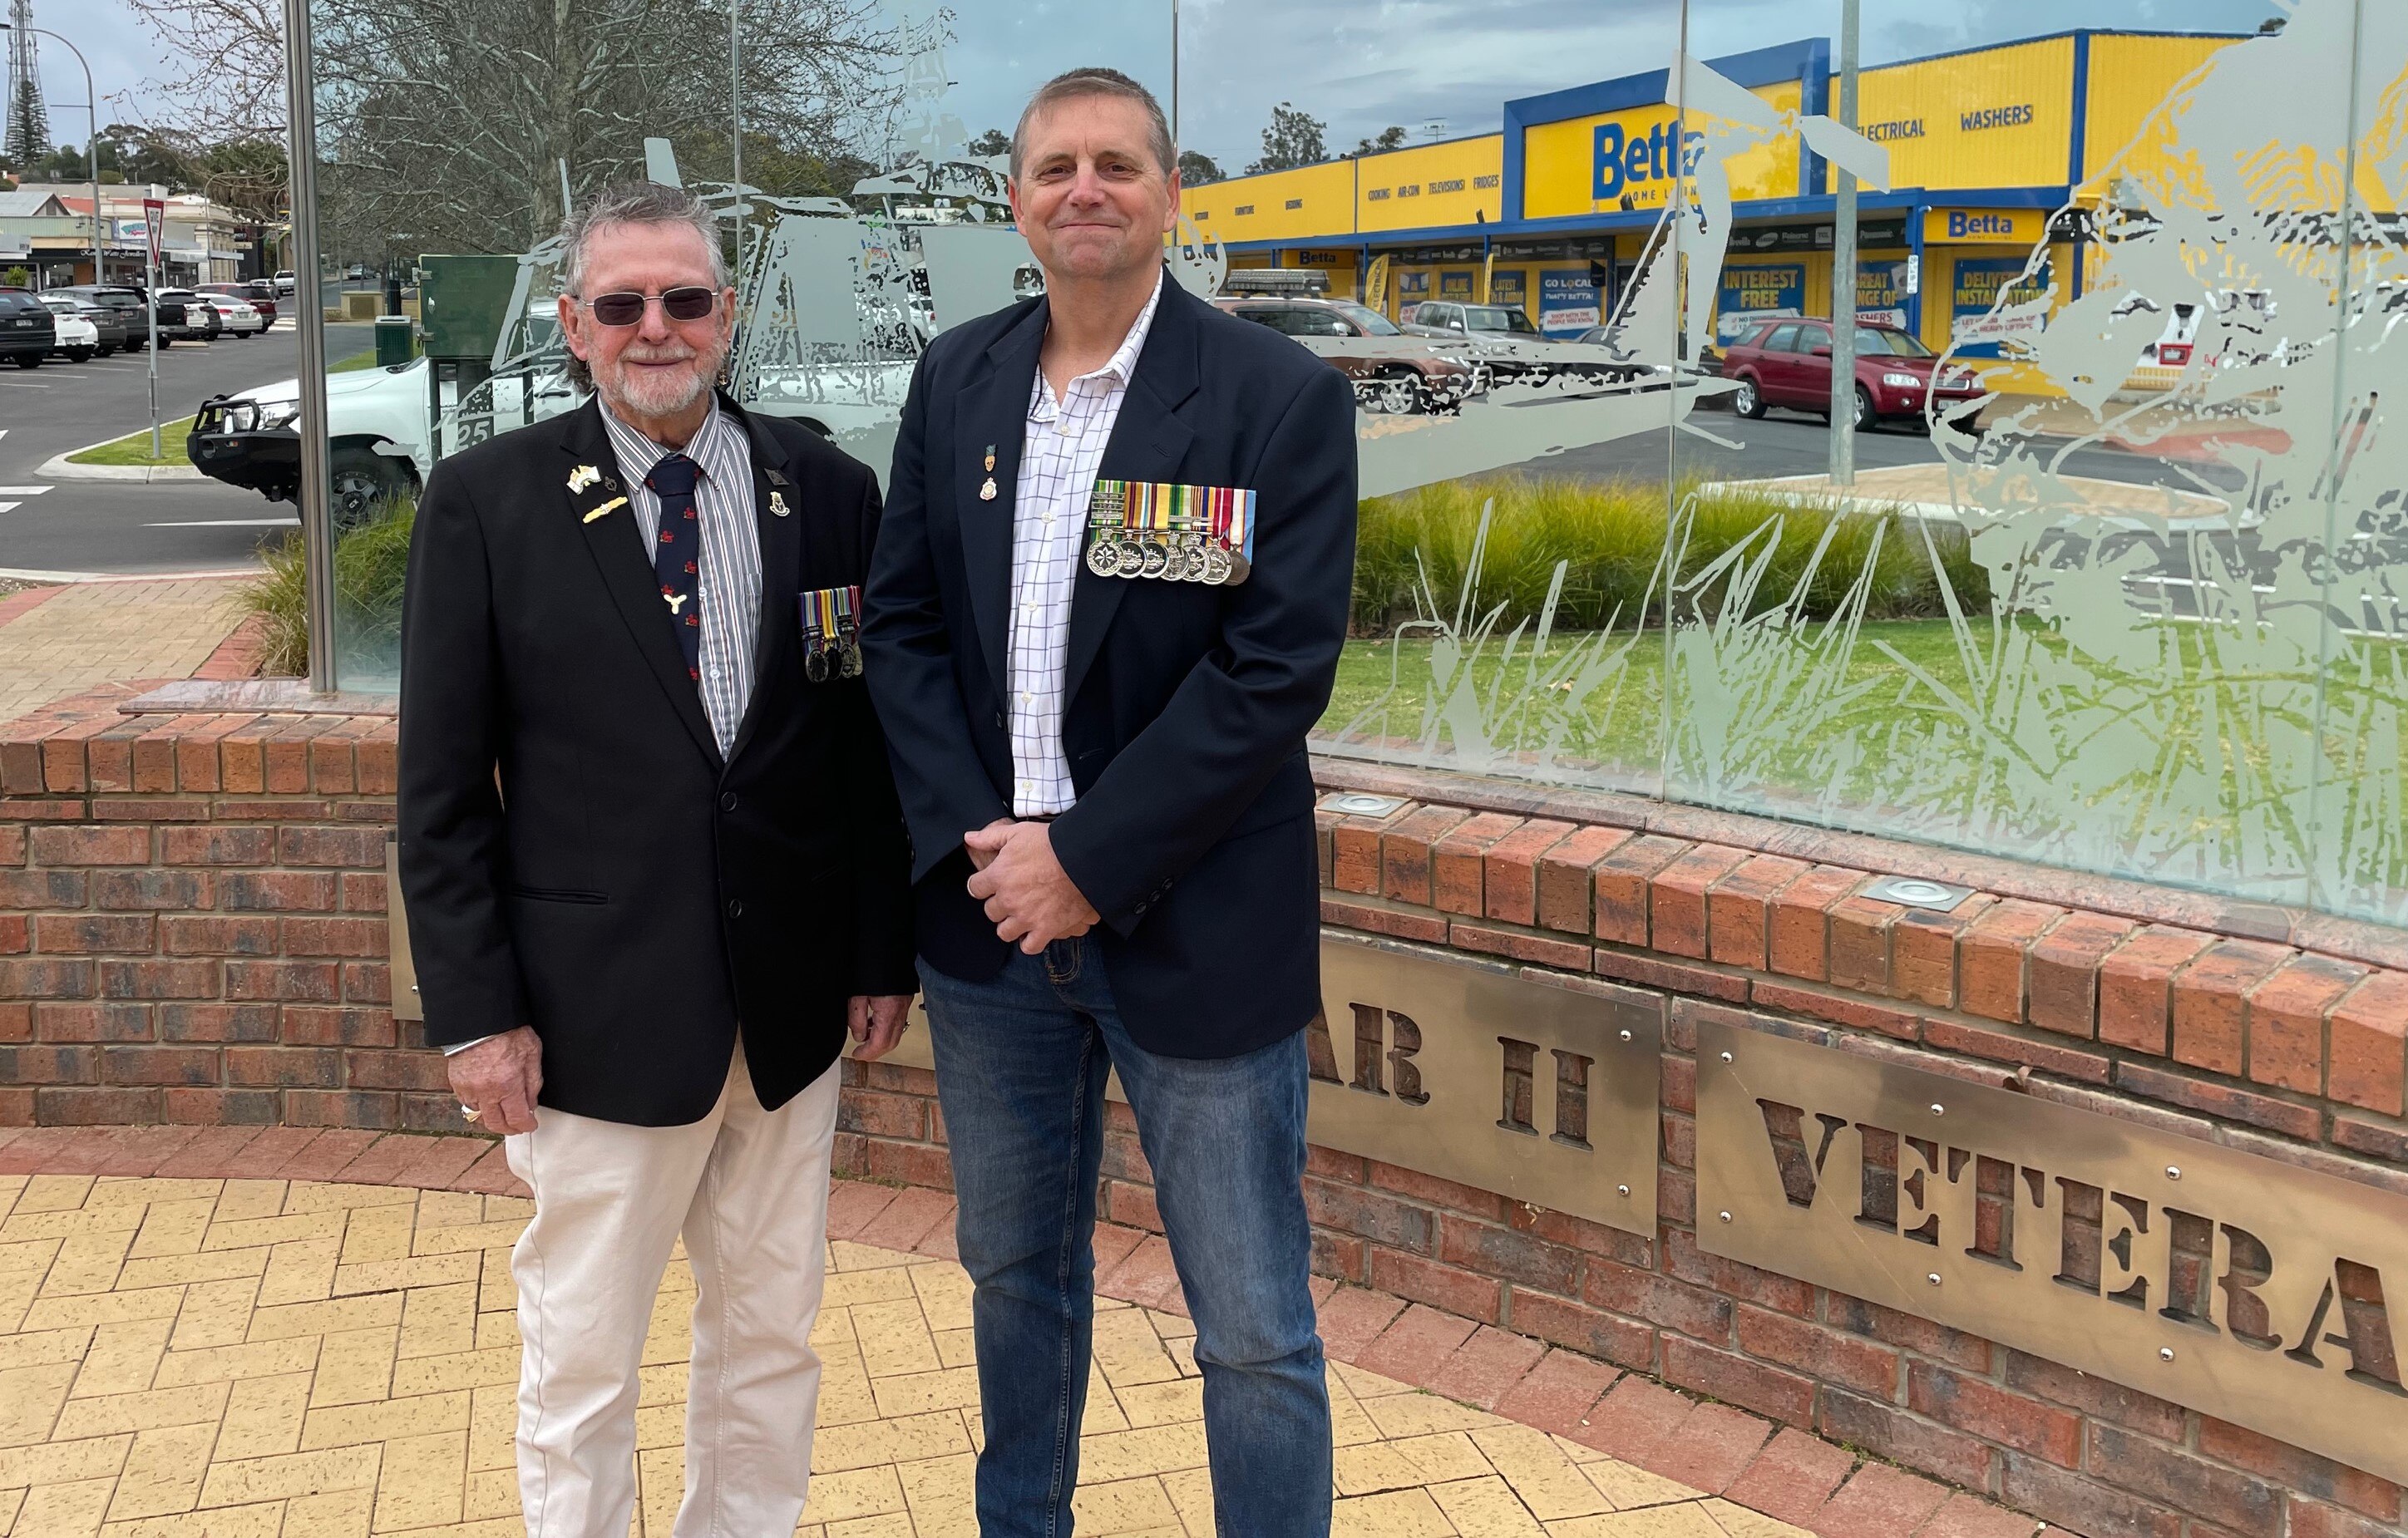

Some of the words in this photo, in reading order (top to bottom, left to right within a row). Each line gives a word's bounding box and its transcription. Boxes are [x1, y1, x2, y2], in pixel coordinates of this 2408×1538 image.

[1960, 104, 2035, 131] WASHERS
[1858, 118, 1926, 141] ECTRICAL
[1473, 174, 1500, 190] FRIDGES
[1948, 211, 2013, 238] Betta
[1299, 250, 1337, 266] Betta
[1494, 279, 1517, 291] LATEST
[1544, 279, 1558, 288] GO
[1560, 279, 1594, 290] LOCAL
[1724, 270, 1798, 288] INTEREST
[1567, 292, 1594, 300] BETTA!
[1740, 289, 1779, 308] FREE
[1856, 290, 1880, 306] NGE
[1882, 290, 1897, 306] OF
[1855, 313, 1893, 323] ASHERS
[1755, 1097, 2408, 1400] VETERA
